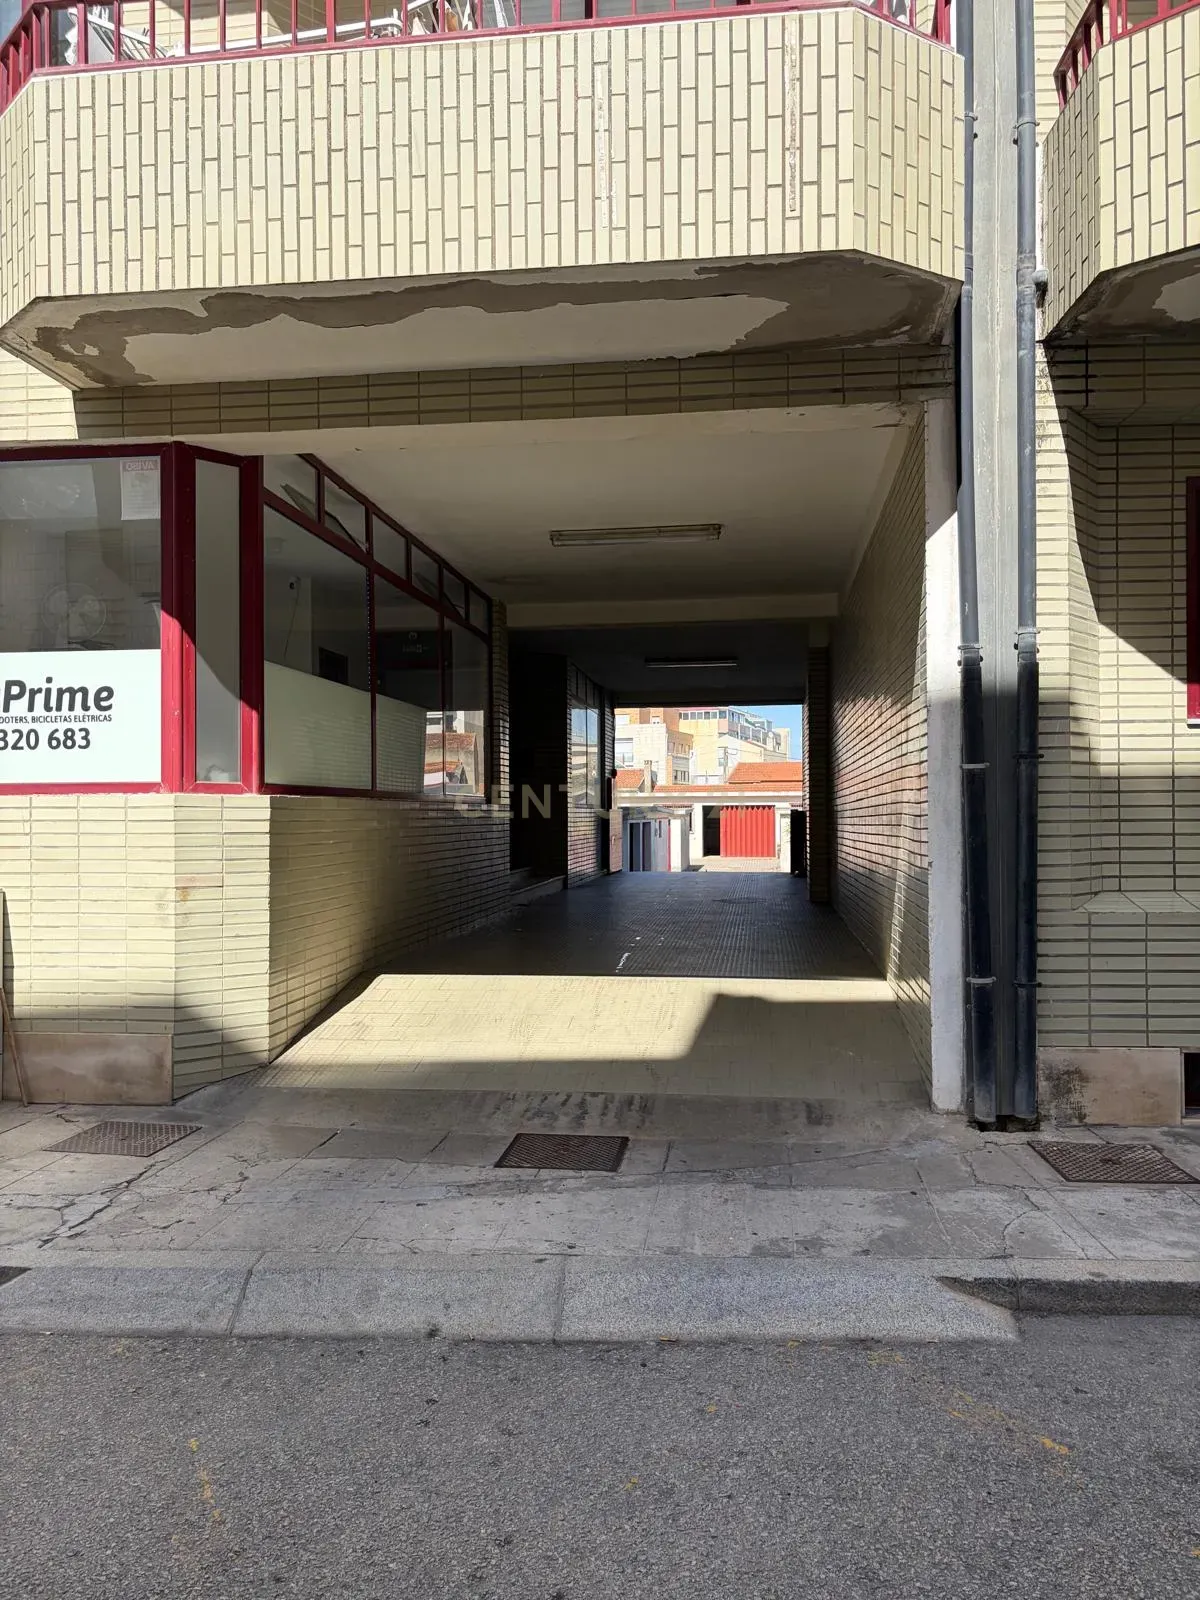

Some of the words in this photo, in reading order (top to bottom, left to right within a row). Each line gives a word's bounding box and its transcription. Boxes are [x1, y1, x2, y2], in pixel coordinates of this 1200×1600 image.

[2, 676, 115, 713] Prime
[31, 714, 72, 724] BICICLETAS
[47, 727, 91, 750] 683
